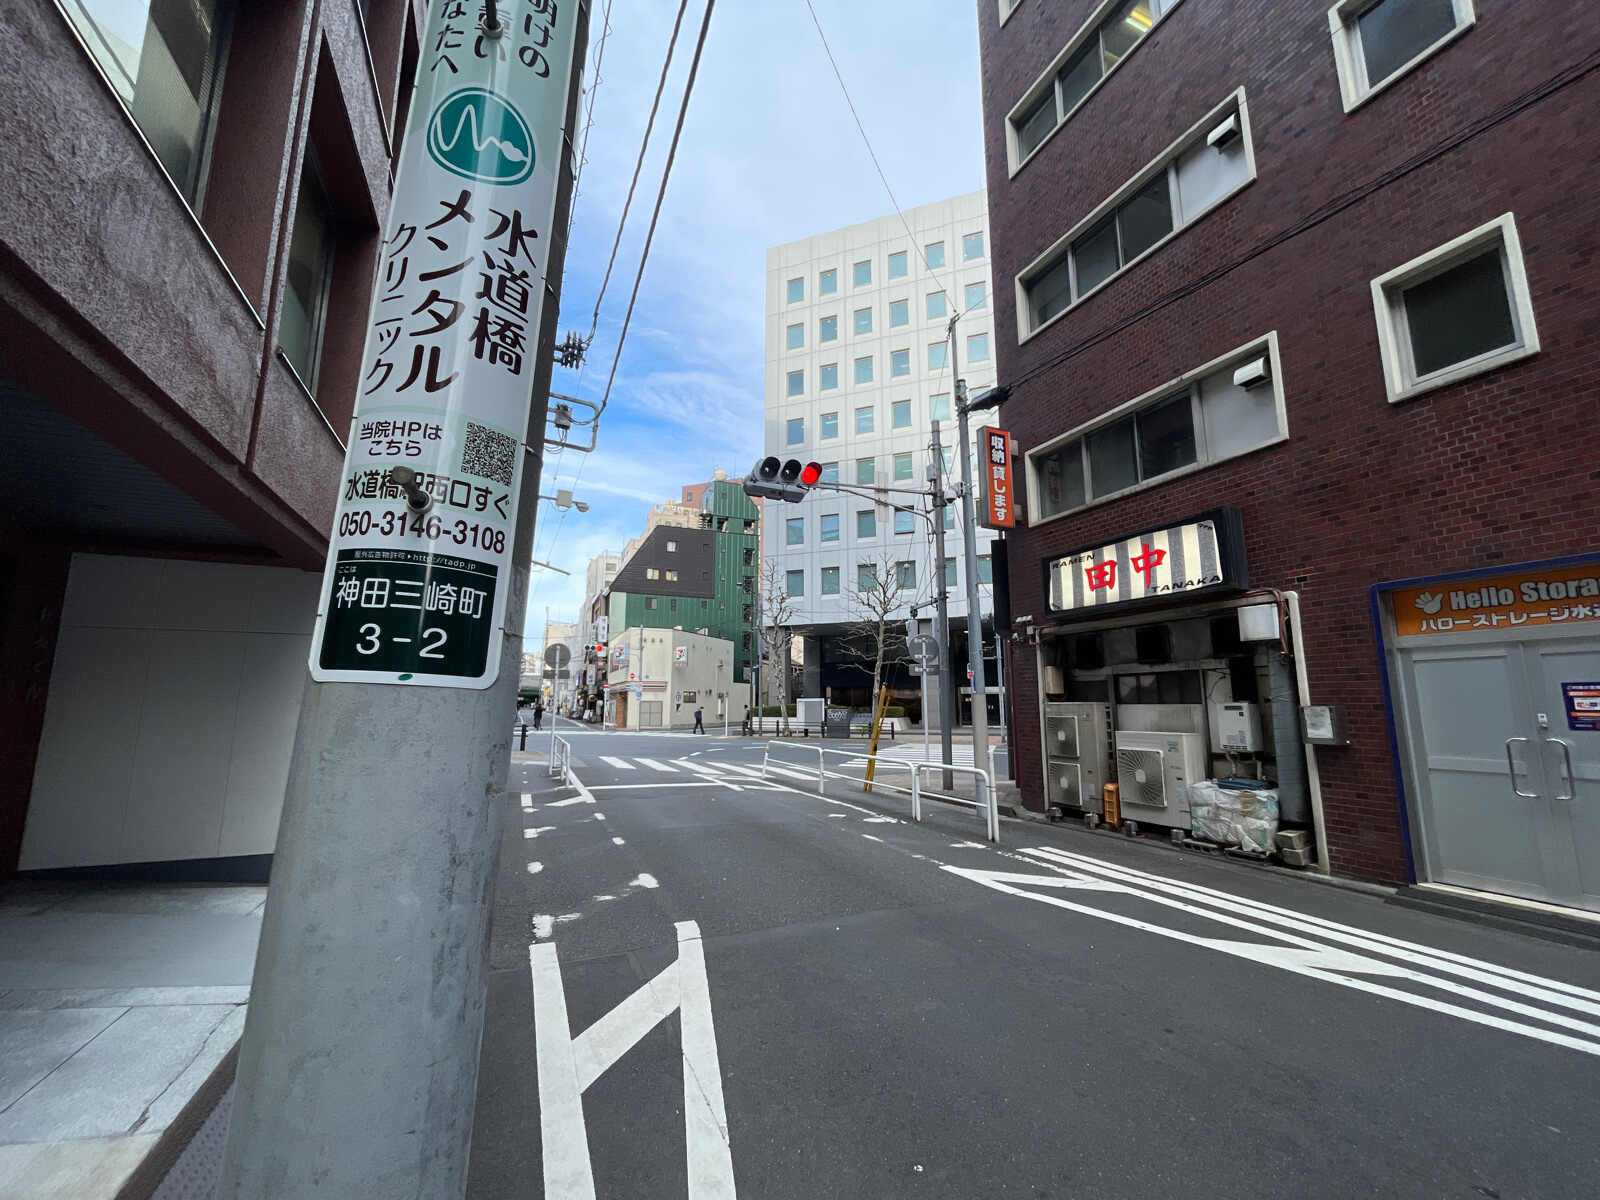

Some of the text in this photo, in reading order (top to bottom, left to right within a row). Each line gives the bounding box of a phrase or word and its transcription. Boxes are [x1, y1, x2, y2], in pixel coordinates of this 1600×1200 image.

[365, 223, 416, 395] クリニック
[395, 189, 476, 393] メンタル
[469, 210, 538, 375] 水道橋
[360, 421, 443, 440] 当院HPは
[368, 440, 422, 456] こちら
[339, 510, 506, 554] 050-3146-3108
[1052, 553, 1095, 569] RAMEN
[1085, 543, 1167, 592] 田中
[336, 576, 488, 619] 神田三崎町
[1151, 575, 1221, 592] TANAKA
[1450, 578, 1600, 610] Hello Stora
